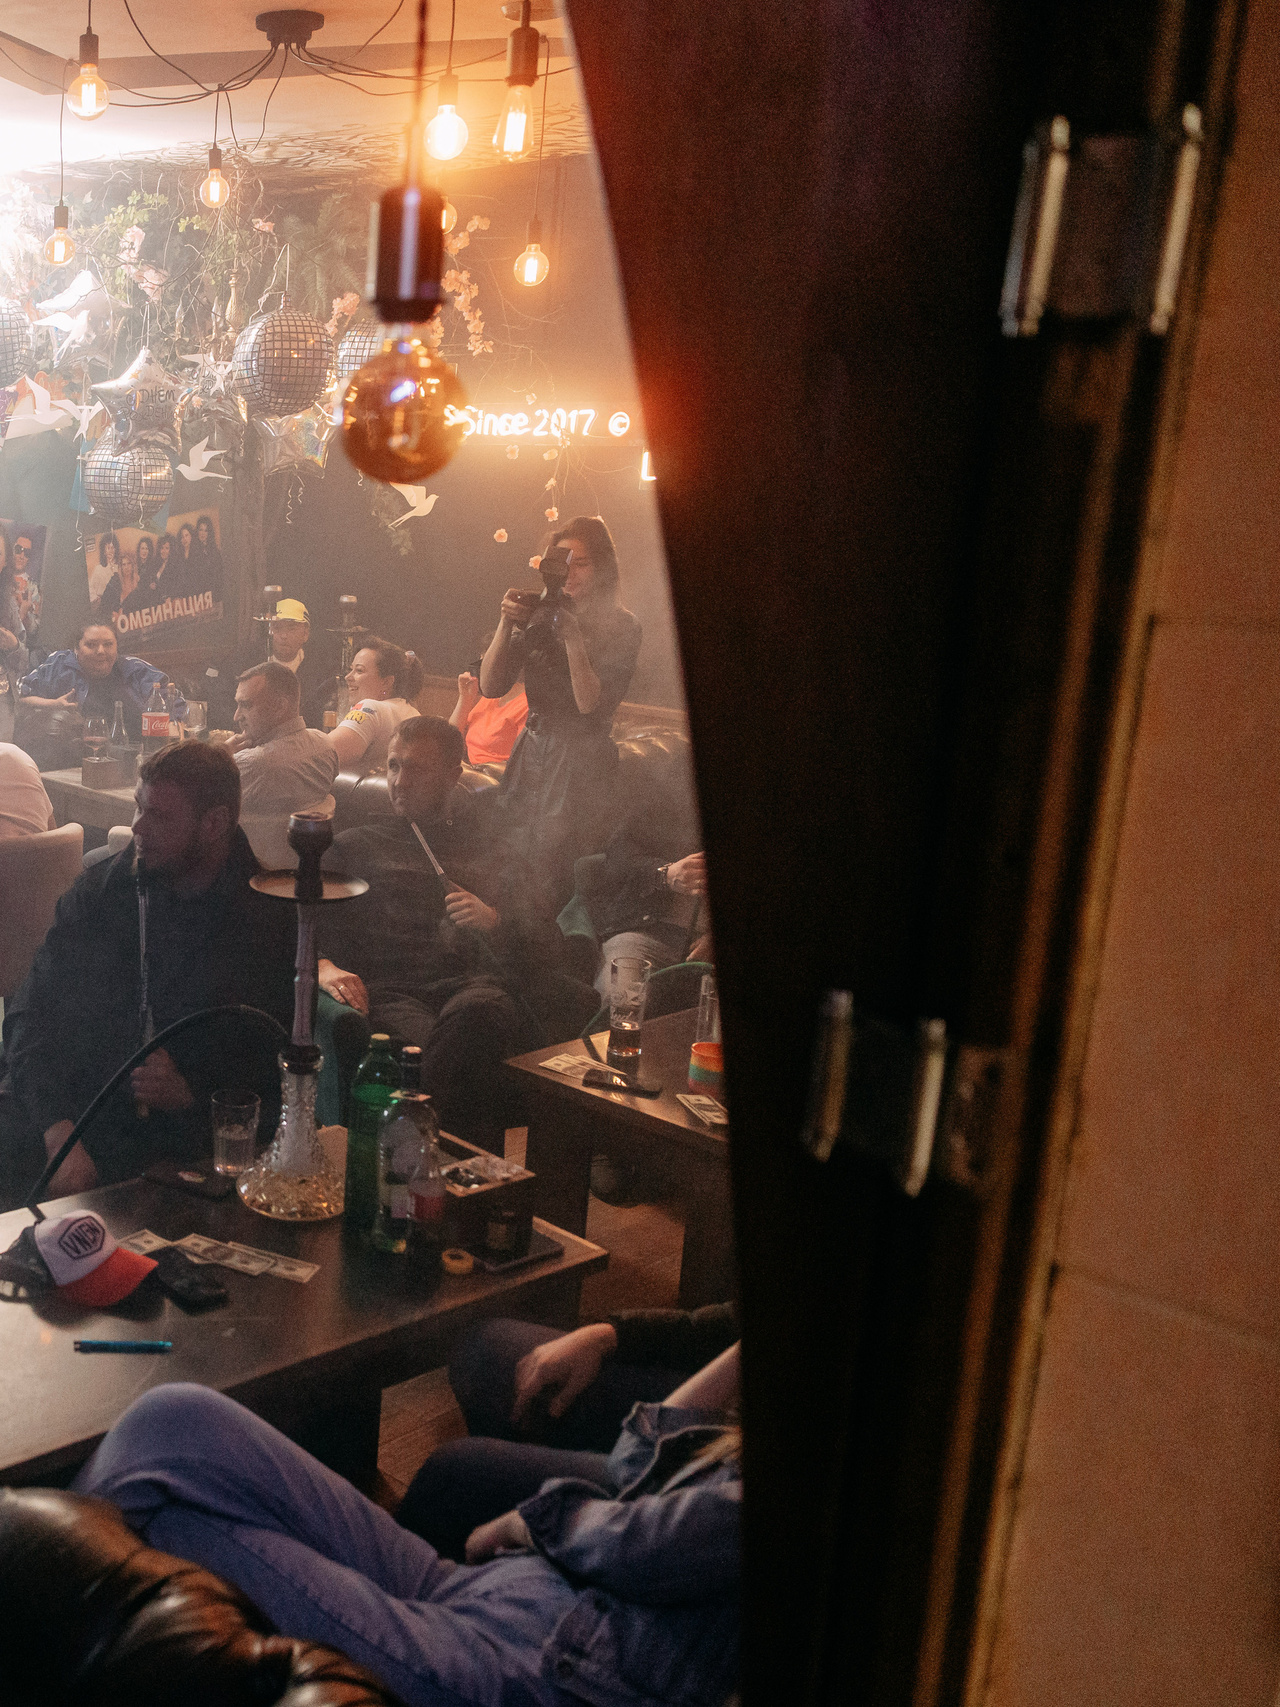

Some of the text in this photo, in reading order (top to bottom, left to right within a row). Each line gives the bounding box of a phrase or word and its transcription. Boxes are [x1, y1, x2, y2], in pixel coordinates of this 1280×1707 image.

[463, 405, 531, 437] Since
[532, 408, 595, 437] 2017
[112, 591, 214, 634] ОМБИНАЦИЯ
